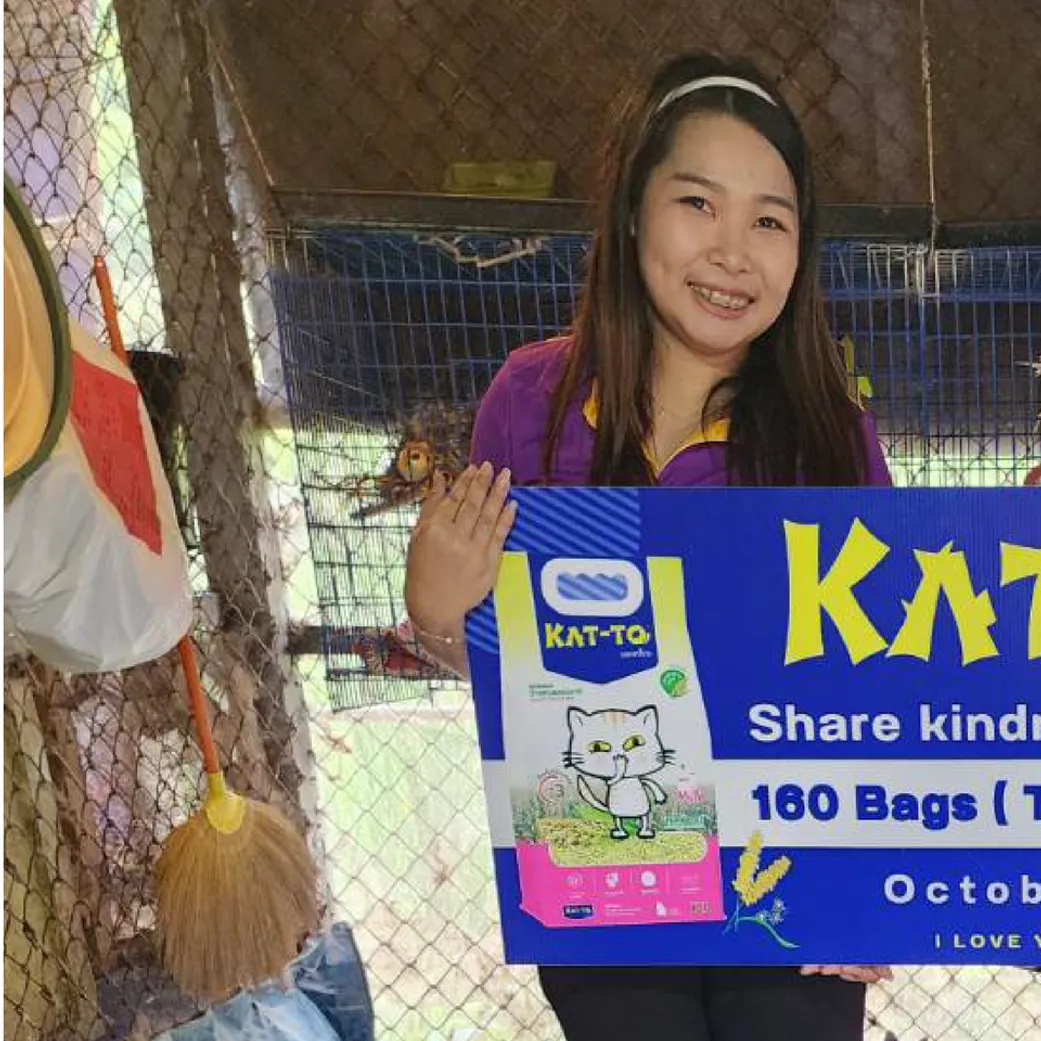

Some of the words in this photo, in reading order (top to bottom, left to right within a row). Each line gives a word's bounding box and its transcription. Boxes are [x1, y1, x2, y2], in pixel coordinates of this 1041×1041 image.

[545, 622, 650, 649] KAT-TO
[749, 703, 901, 742] Share
[752, 783, 840, 821] 160
[855, 784, 978, 831] Bags
[935, 933, 942, 949] I
[953, 933, 1022, 949] LOVE
